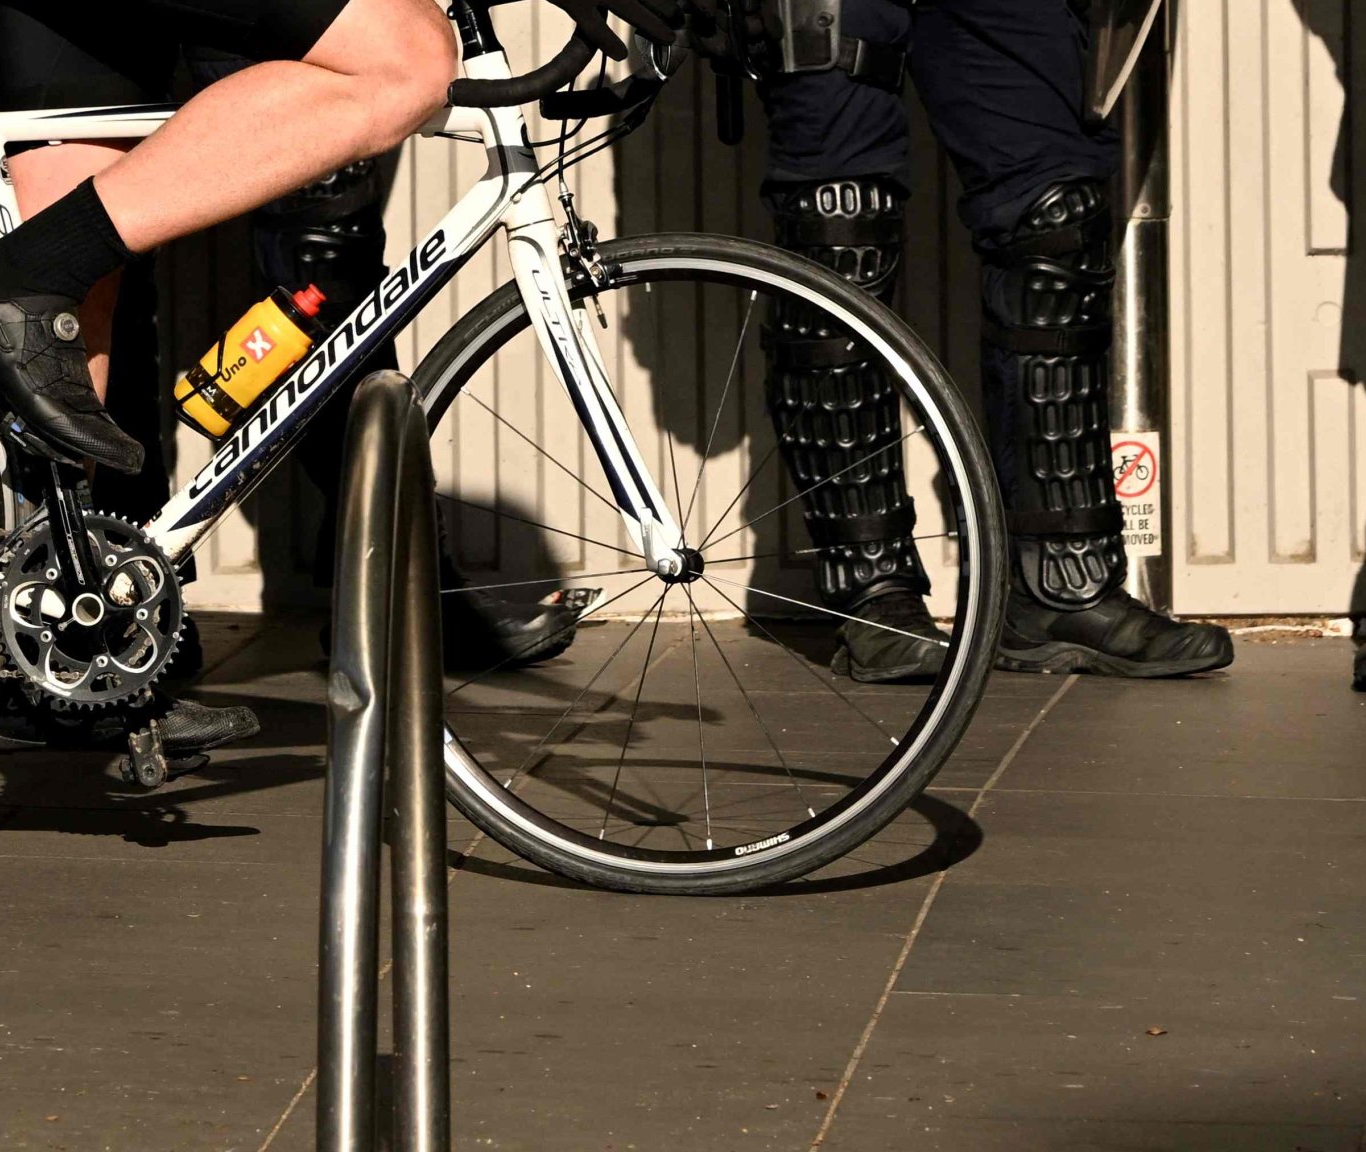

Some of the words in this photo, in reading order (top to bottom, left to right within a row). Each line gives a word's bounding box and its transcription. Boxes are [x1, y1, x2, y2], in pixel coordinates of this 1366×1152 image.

[188, 228, 447, 500] cannondale
[220, 356, 247, 383] Uno
[245, 328, 273, 361] X
[1124, 533, 1155, 545] MOVED
[1138, 518, 1149, 530] BE
